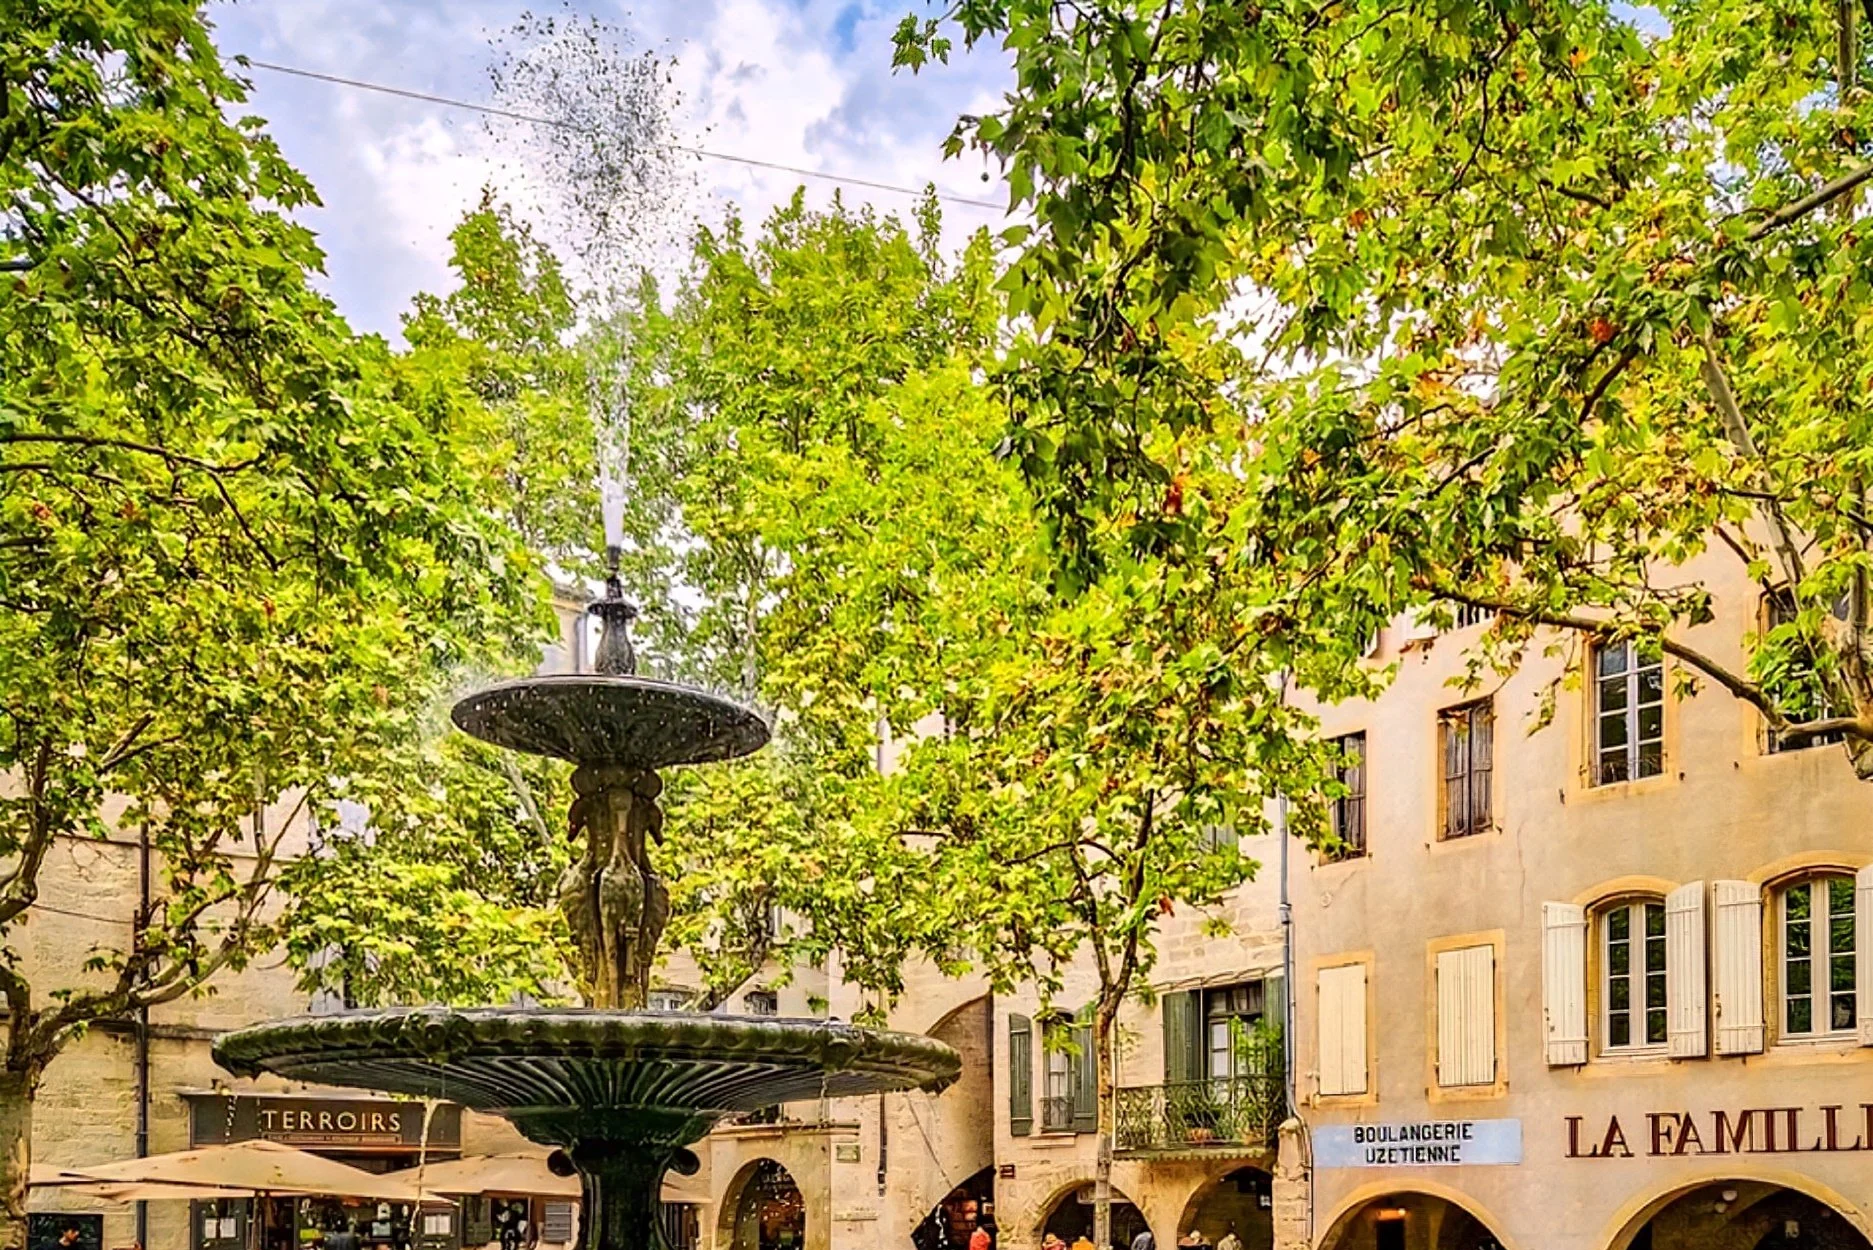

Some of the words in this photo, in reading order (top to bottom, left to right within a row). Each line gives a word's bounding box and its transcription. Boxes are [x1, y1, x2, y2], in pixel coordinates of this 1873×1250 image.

[261, 1110, 401, 1132] TERROIRS
[1354, 1123, 1474, 1143] BOULANGERIE
[1564, 1115, 1635, 1158] LA
[1366, 1144, 1461, 1164] UZETIENNE
